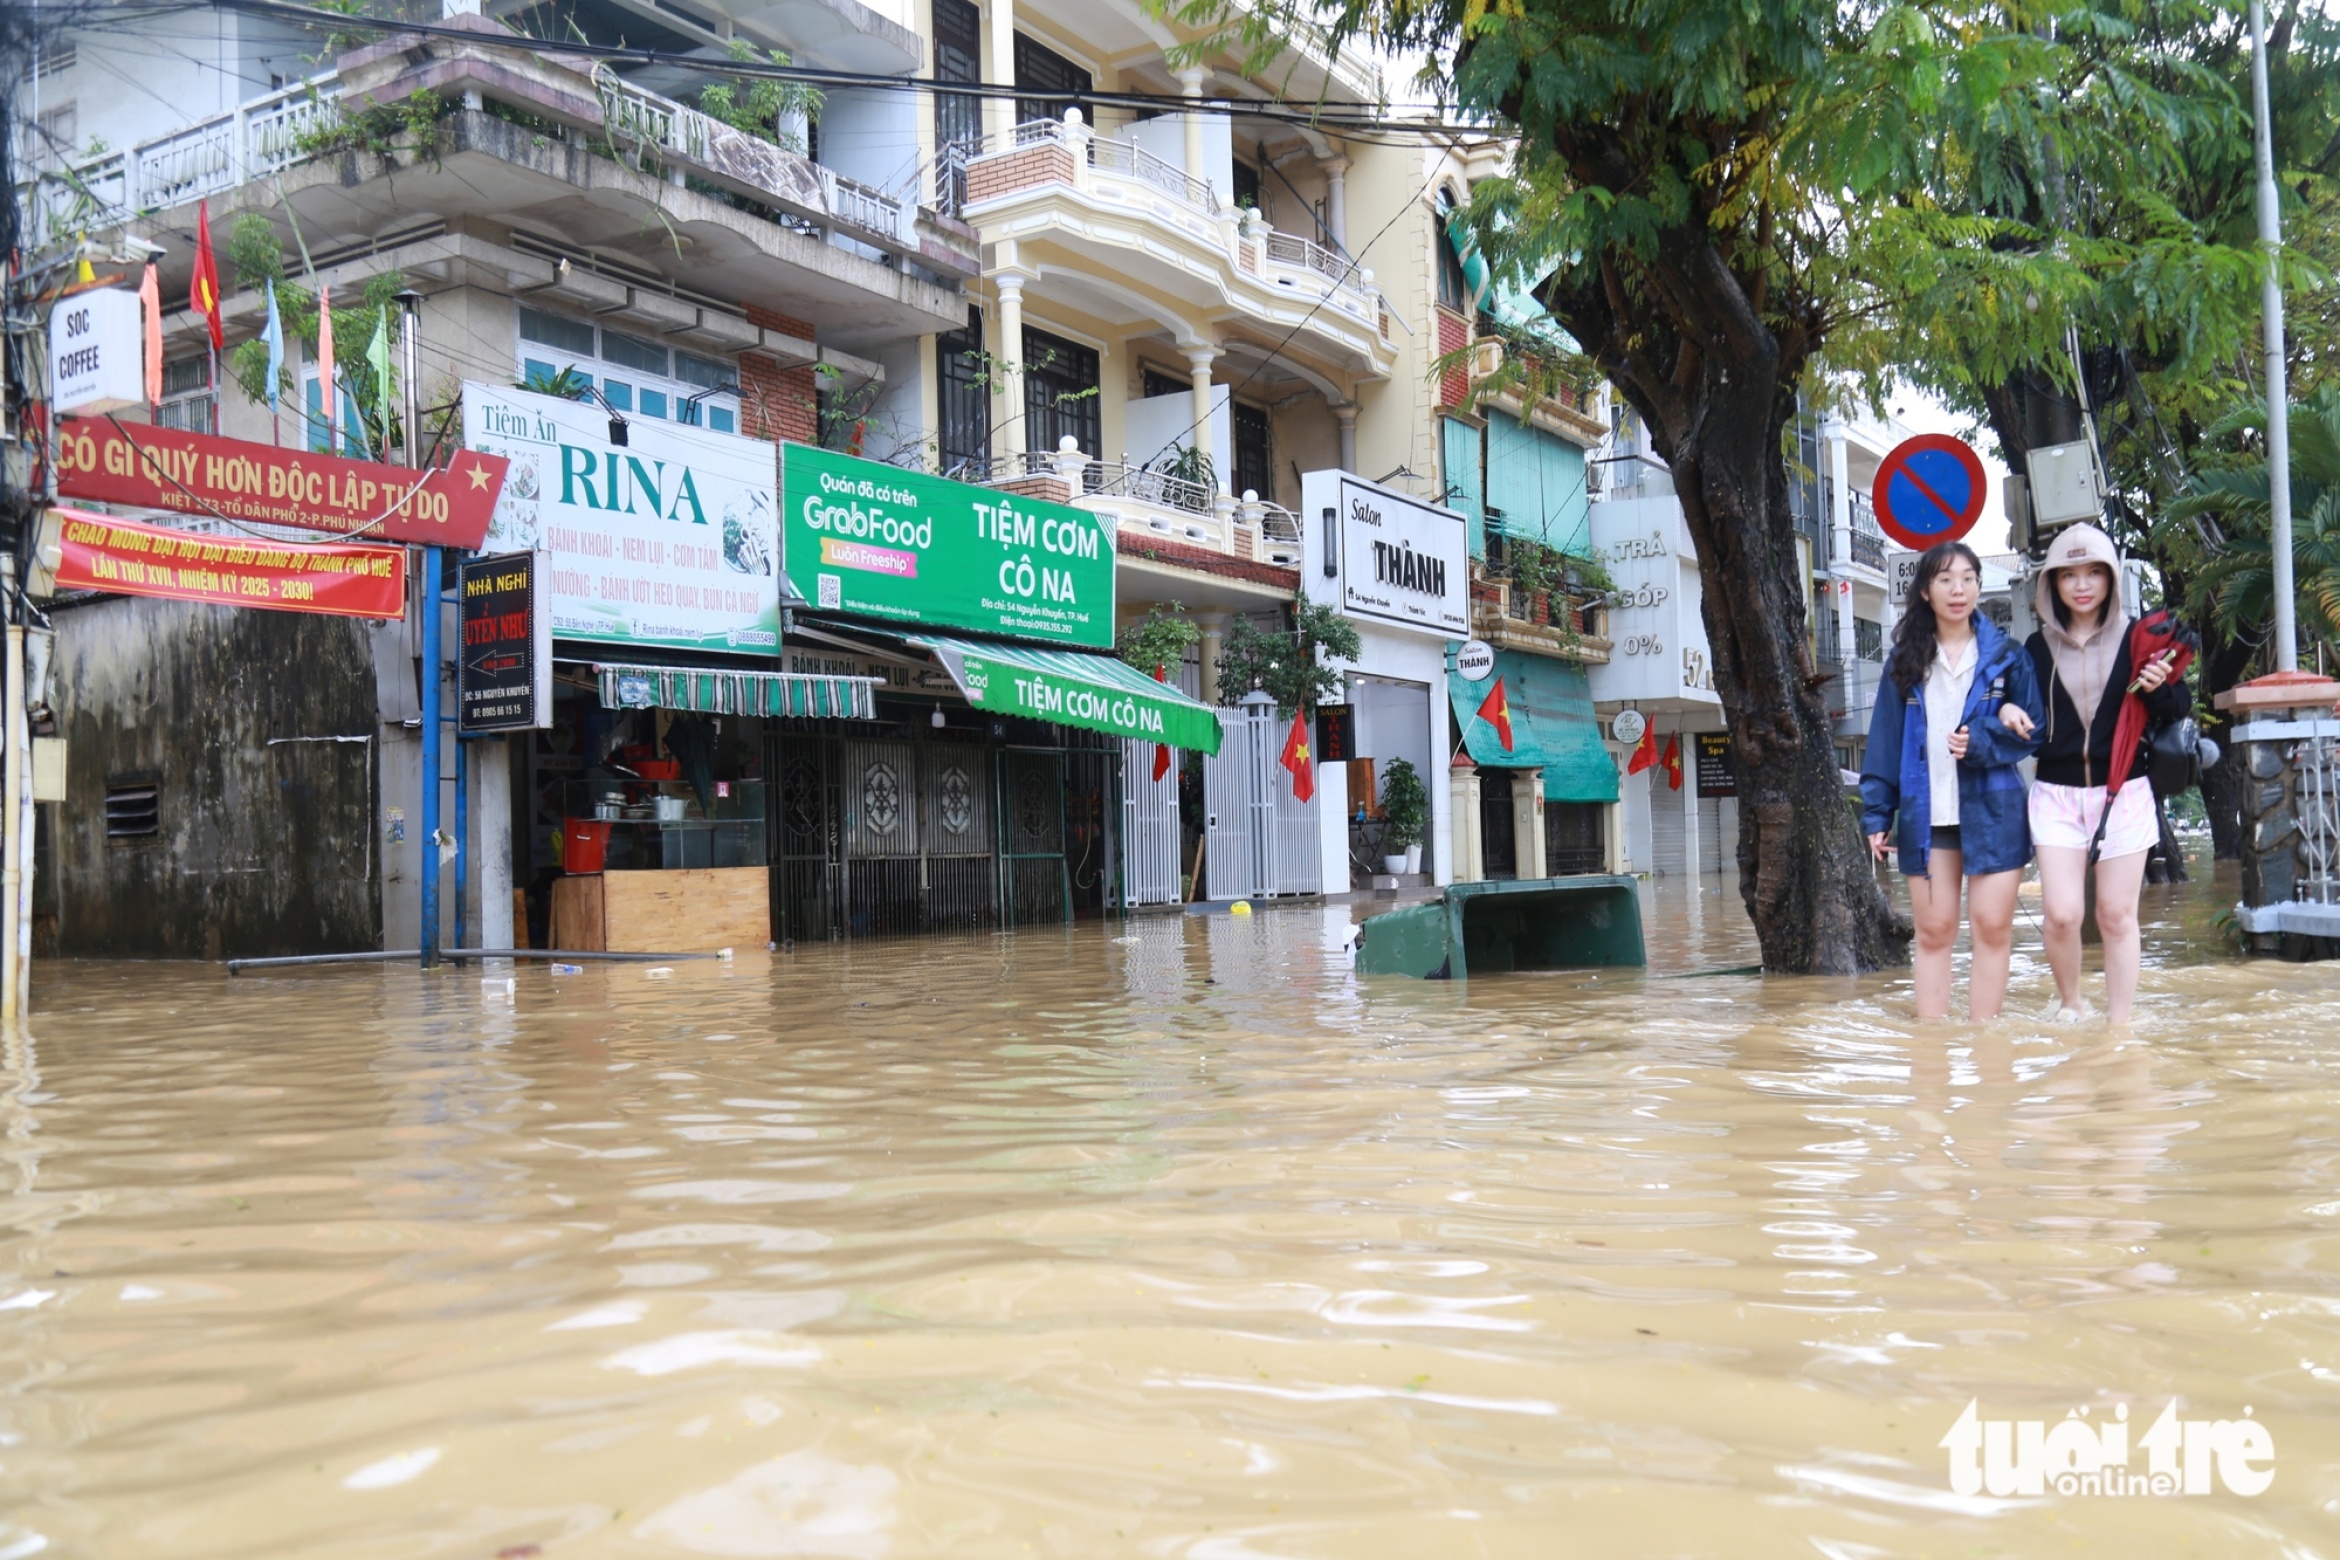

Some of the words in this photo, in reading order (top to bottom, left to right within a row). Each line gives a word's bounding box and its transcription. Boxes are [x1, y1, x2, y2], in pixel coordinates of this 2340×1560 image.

[67, 308, 89, 338] SOC
[60, 345, 100, 380] COFFEE
[482, 404, 527, 440] Tiệm
[534, 408, 557, 442] Ăn
[58, 426, 97, 473] CÓ
[104, 433, 134, 477] GÌ
[142, 444, 199, 488] QUÝ
[206, 455, 262, 495] HƠN
[269, 461, 323, 509] ĐỘC
[329, 470, 377, 514] LẬP
[381, 481, 414, 524] TỰ
[418, 489, 449, 523] DO
[558, 443, 709, 525] RINA
[820, 472, 855, 495] Quán
[857, 480, 874, 498] đã
[876, 485, 890, 503] có
[892, 489, 917, 508] trên
[161, 491, 191, 509] KIỆT
[244, 501, 270, 518] DÂN
[348, 517, 385, 535] NHUẬN
[803, 495, 932, 549] GrabFood
[972, 499, 1036, 551] TIỆM
[1042, 518, 1098, 560] CƠM
[1351, 498, 1382, 528] Salon
[67, 521, 108, 545] CHÀO
[108, 526, 152, 552] MỪNG
[151, 536, 175, 559] ĐẠI
[178, 538, 201, 563] HỘI
[202, 543, 225, 565] ĐẠI
[227, 543, 257, 565] BIỂU
[255, 545, 291, 568] ĐẢNG
[289, 550, 307, 573] BỘ
[308, 551, 345, 573] THÀNH
[346, 553, 372, 576] PHỐ
[371, 554, 394, 578] HUẾ
[547, 522, 577, 554] BÁNH
[581, 529, 613, 558] KHOÁI
[623, 537, 646, 562] NEM
[649, 540, 664, 569] LỤI
[674, 543, 695, 568] CƠM
[831, 543, 859, 564] Luôn
[1615, 530, 1667, 559] TRẢ
[91, 552, 117, 579] LẦN
[120, 559, 144, 584] THỨ
[148, 564, 176, 590] XVII,
[178, 567, 220, 595] NHIỆM
[222, 570, 237, 594] KỲ
[241, 576, 270, 597] 2025
[281, 580, 314, 601] 2030!
[467, 574, 492, 597] NHÀ
[497, 567, 527, 592] NGHỈ
[999, 554, 1036, 597] CÔ
[1042, 567, 1076, 604] NA
[1371, 539, 1446, 598] THÀNH
[552, 567, 590, 598] NƯỚNG
[601, 571, 629, 601] BÁNH
[633, 576, 651, 604] ƯỚT
[654, 582, 673, 606] HEO
[703, 584, 722, 611] BÚN
[725, 586, 738, 612] CÁ
[740, 589, 759, 614] NGỪ
[1619, 582, 1668, 608] GÓP
[465, 602, 498, 646] UYỂN
[500, 607, 529, 640] NHƯ
[981, 598, 993, 610] Địa
[1007, 602, 1015, 611] 54
[1016, 604, 1040, 616] Nguyễn
[1078, 612, 1089, 623] Huế
[1000, 615, 1015, 627] Điện
[1459, 655, 1490, 669] THÀNH
[1624, 633, 1663, 656] 0%
[791, 652, 821, 674] BÁNH
[893, 667, 909, 690] LỤI
[505, 705, 512, 715] 15
[514, 704, 521, 714] 15
[1014, 676, 1062, 715] TIỆM
[1066, 690, 1109, 723] CƠM
[1112, 697, 1136, 729] CÔ
[1140, 706, 1164, 734] NA
[1320, 708, 1347, 716] SALON
[1701, 735, 1731, 745] Beauty
[1708, 746, 1724, 756] Spa
